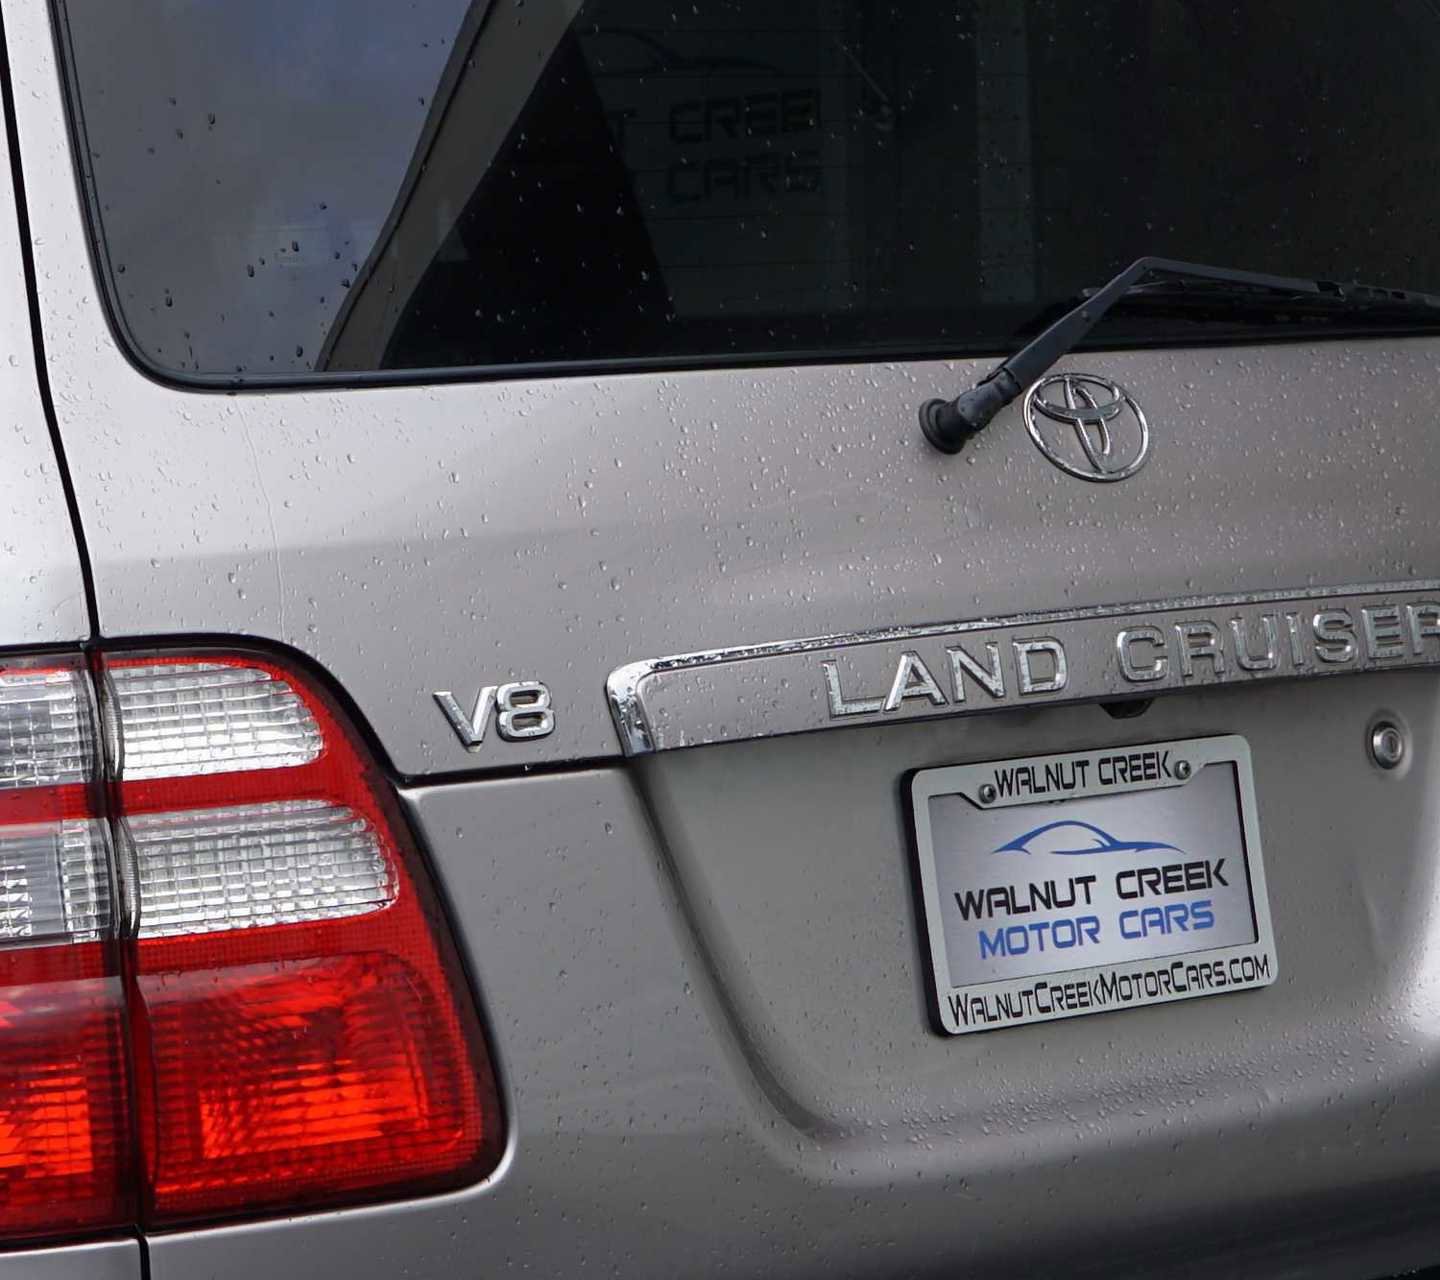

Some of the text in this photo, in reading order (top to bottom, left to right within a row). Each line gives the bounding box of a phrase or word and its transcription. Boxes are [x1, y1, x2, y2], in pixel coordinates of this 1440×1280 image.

[822, 634, 1068, 719] LAND
[432, 680, 556, 752] V8
[994, 750, 1172, 799] WALNUT CREEK
[954, 858, 1229, 921] WALNUT CREEK
[978, 899, 1216, 960] MOTOR CARS
